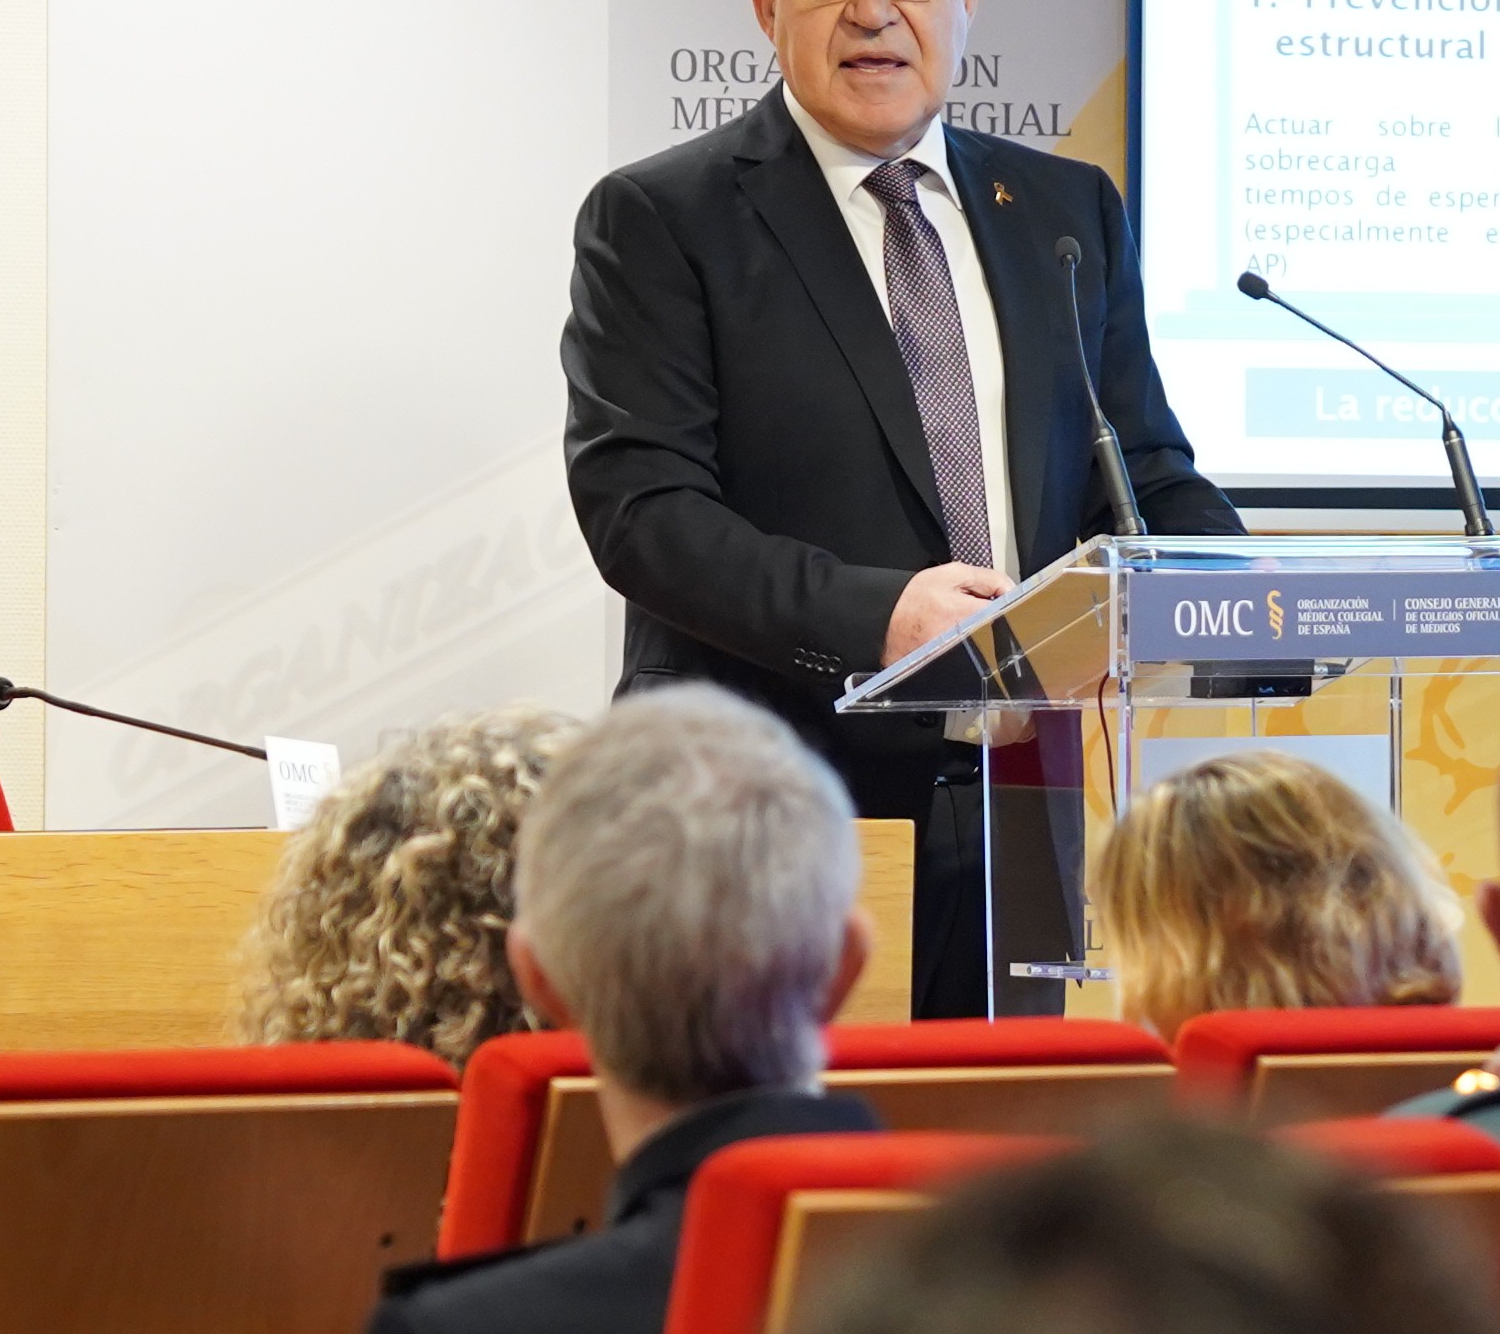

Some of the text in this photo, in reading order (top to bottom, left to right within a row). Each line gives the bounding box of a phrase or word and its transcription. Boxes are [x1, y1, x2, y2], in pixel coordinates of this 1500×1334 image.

[1275, 30, 1486, 60] estructural
[1244, 113, 1334, 136] Actuar
[1377, 114, 1452, 138] sobre
[1244, 147, 1396, 178] sobrecarga
[1244, 185, 1354, 211] tiempos
[1375, 184, 1407, 207] de
[1245, 218, 1450, 246] (especialmente
[1314, 386, 1361, 424] La
[1297, 596, 1369, 610] ORGANIZACIÓN
[1404, 598, 1452, 610] CONSEJO
[1173, 598, 1254, 637] OMC
[1297, 621, 1351, 635] DE ESPAÑA
[1337, 611, 1384, 622] COLEGIAL
[1405, 611, 1417, 622] DE
[1419, 611, 1464, 622] COLEGIOS
[1405, 623, 1417, 634] DE
[279, 760, 320, 785] OMC
